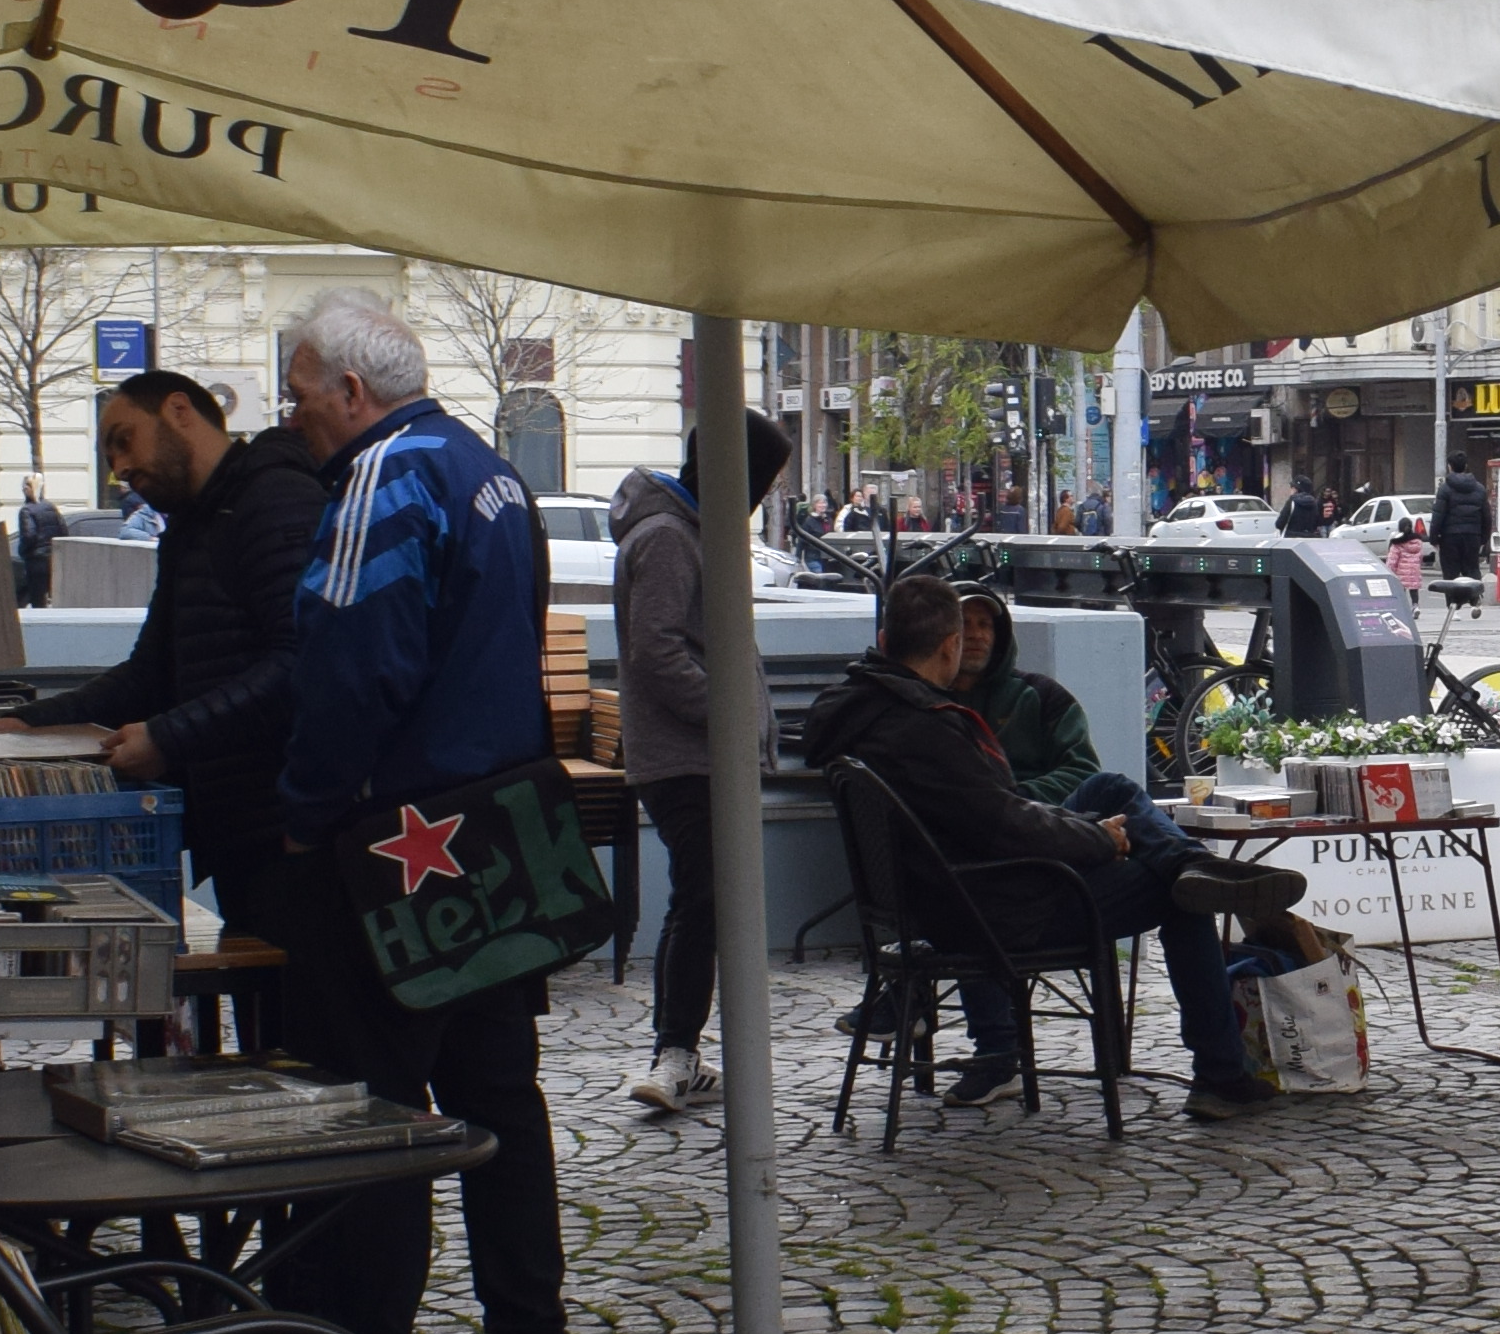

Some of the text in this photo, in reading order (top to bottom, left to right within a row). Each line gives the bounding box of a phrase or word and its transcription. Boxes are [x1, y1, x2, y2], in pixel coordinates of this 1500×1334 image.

[1150, 368, 1247, 391] ED'S COFFEE CO.
[1356, 865, 1432, 876] CHAEAU
[1281, 1014, 1308, 1073] Mega Chic
